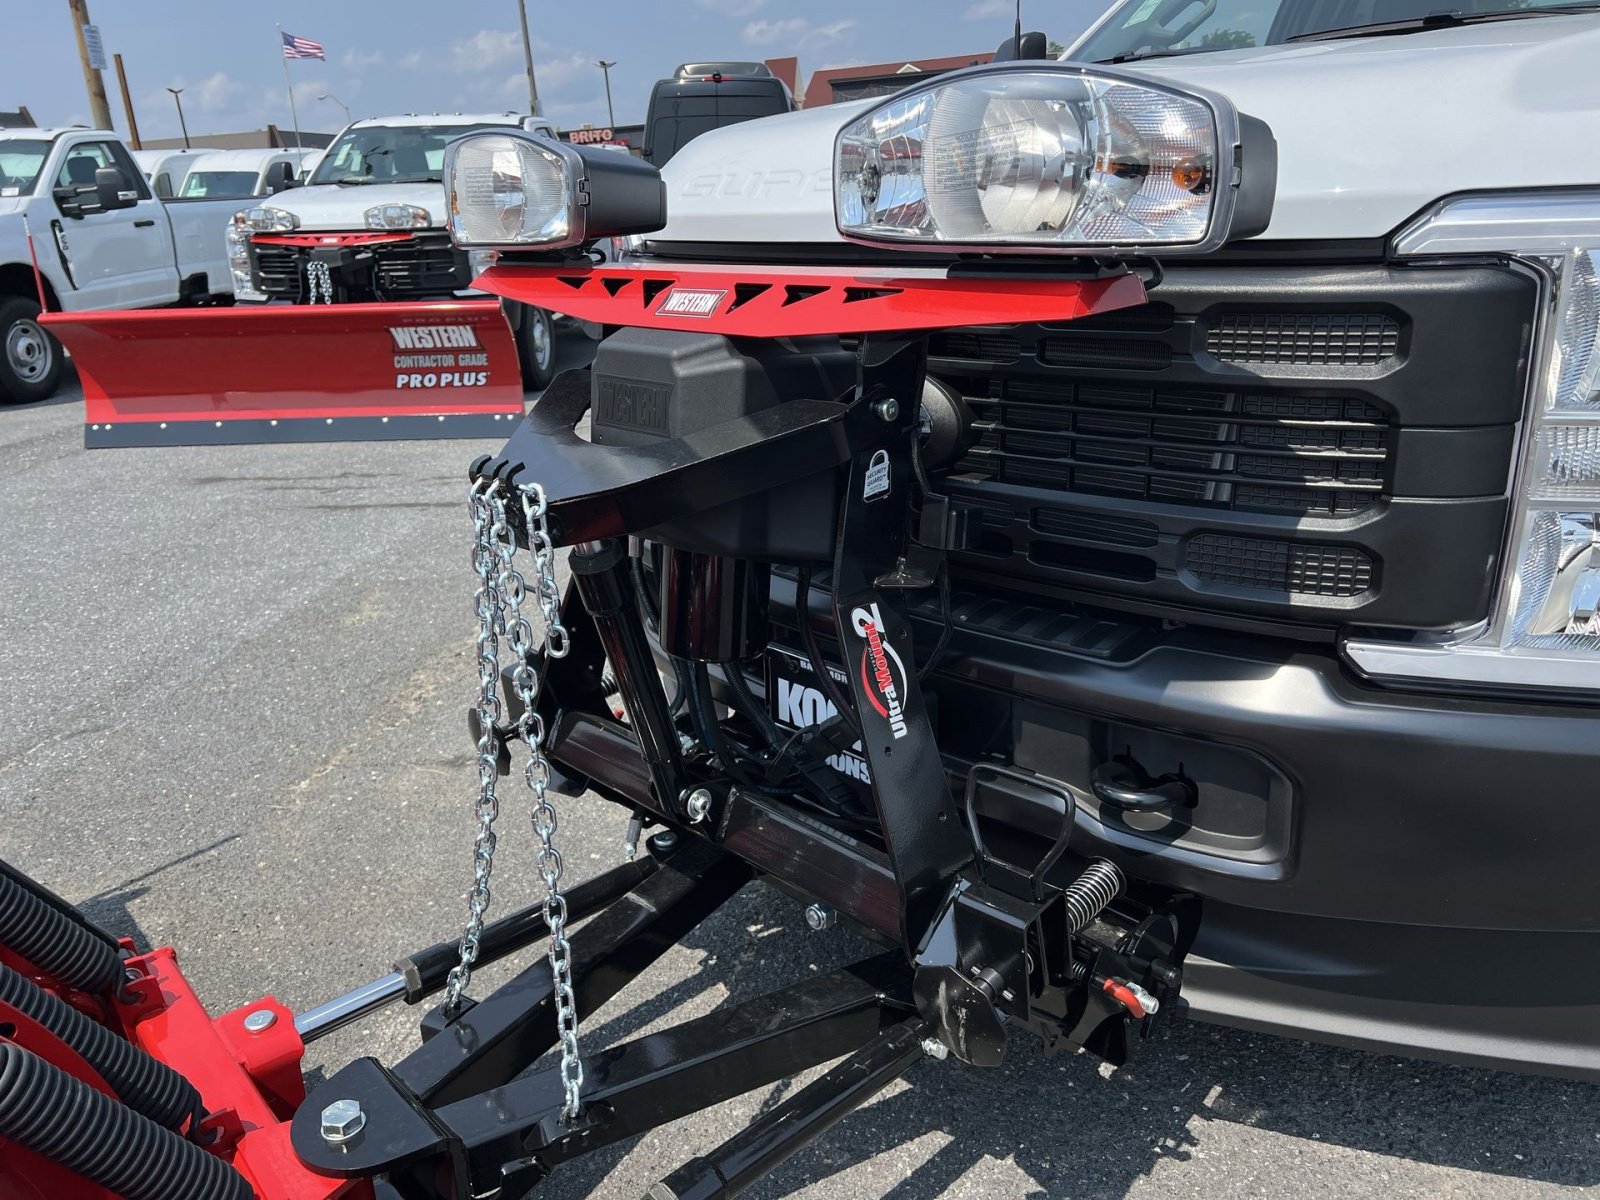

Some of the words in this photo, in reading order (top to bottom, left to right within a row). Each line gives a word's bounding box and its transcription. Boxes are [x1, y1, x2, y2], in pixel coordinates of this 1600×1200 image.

[569, 129, 613, 144] BRITO
[665, 292, 720, 313] WESTERN
[389, 325, 477, 349] WESTERN
[394, 355, 455, 368] CONTRACTOR
[458, 353, 488, 366] GRADE
[599, 380, 669, 430] WESTERN
[867, 466, 887, 479] SECURITY
